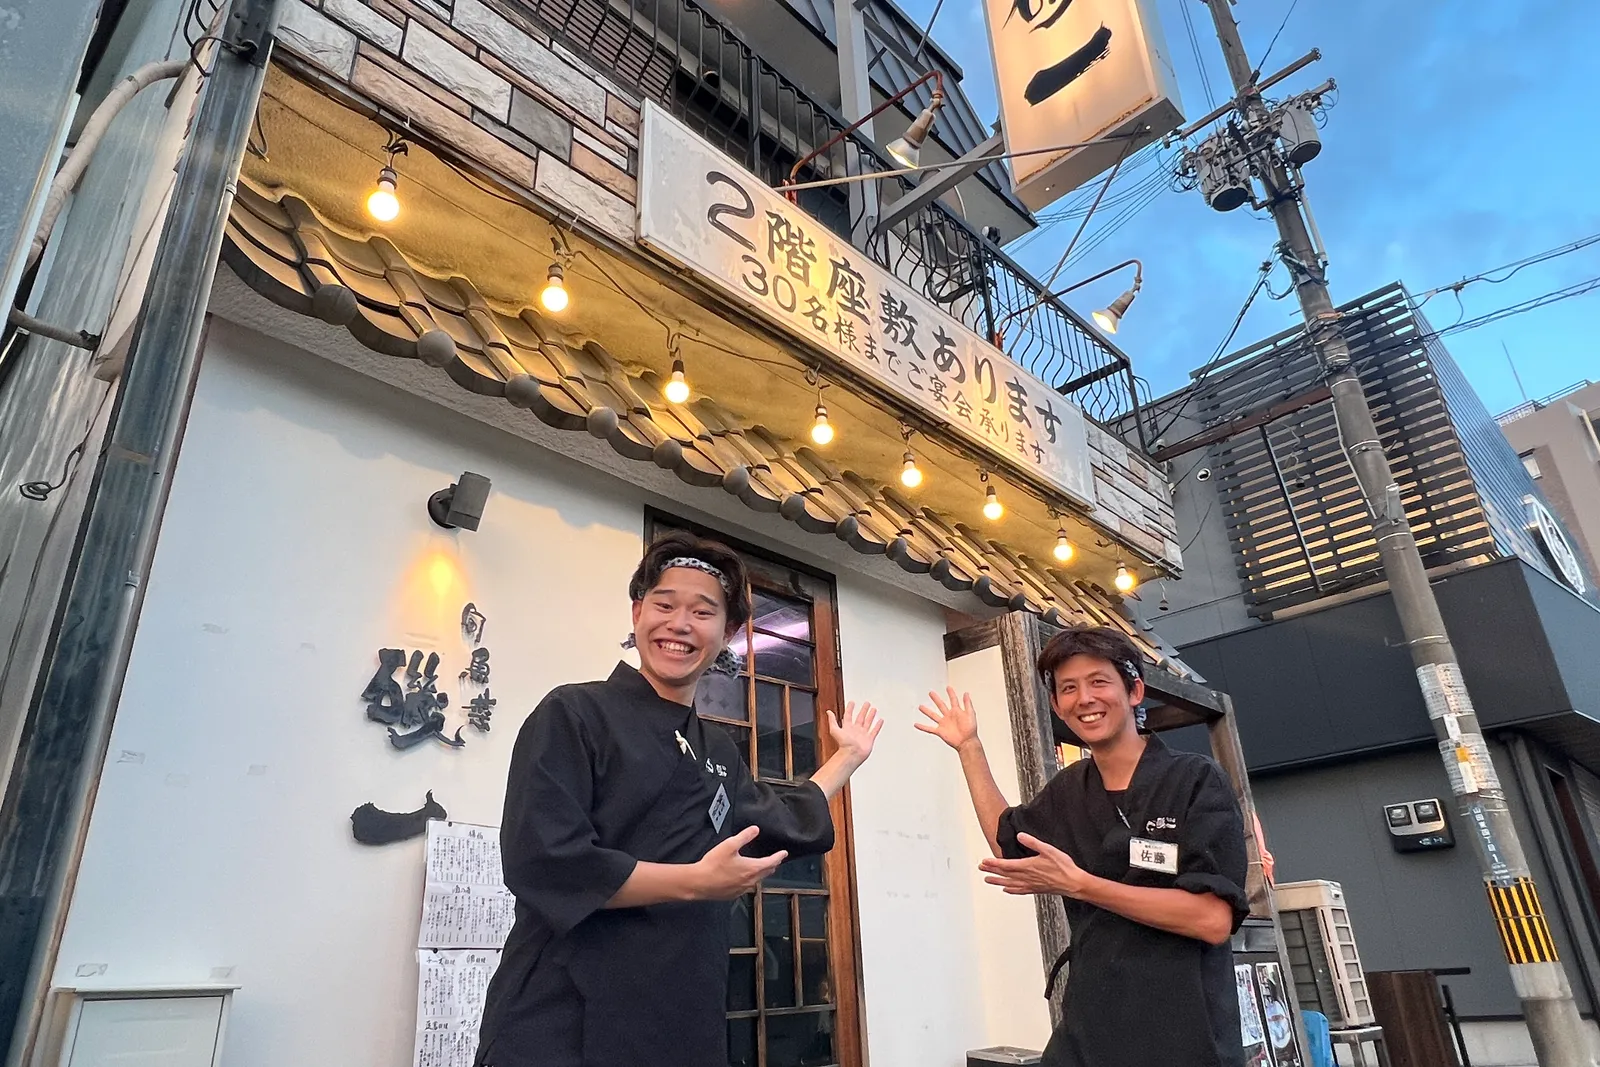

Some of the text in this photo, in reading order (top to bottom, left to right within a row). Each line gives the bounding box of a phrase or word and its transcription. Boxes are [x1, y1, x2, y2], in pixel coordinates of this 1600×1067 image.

[705, 170, 1062, 445] 2階座敷あります
[741, 254, 1046, 465] 30名様までご宴会承ります
[1141, 850, 1166, 865] 佐藤
